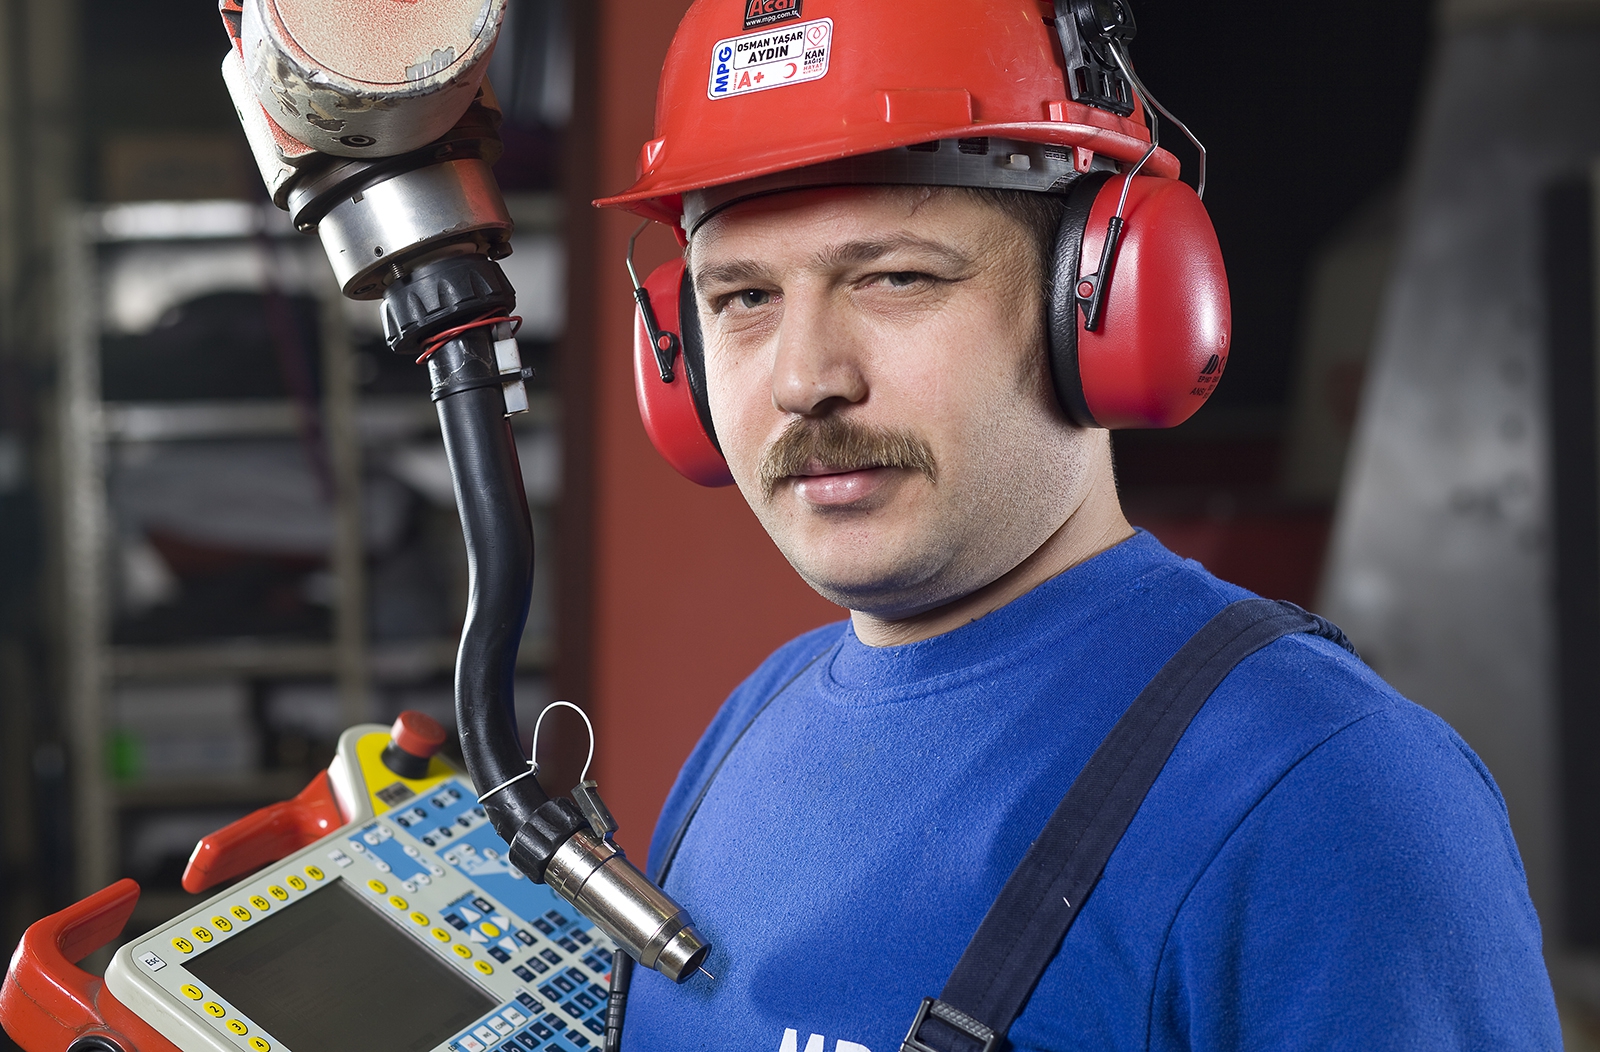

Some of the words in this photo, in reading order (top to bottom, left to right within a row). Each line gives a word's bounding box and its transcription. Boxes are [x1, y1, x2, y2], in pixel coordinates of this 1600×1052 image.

[745, 10, 798, 26] www.mpg.com.tr
[737, 38, 770, 52] OSMAN
[772, 31, 803, 45] YAŞAR
[748, 45, 789, 63] AYDIN
[804, 48, 825, 60] KAN
[715, 46, 732, 92] MPG
[737, 71, 764, 89] A+
[290, 878, 302, 888] F7
[272, 888, 284, 898] F6
[253, 898, 266, 908] F5
[234, 908, 246, 919] F4
[215, 919, 228, 929] F3
[196, 929, 209, 940] F2
[177, 940, 190, 950] F1
[144, 956, 160, 967] Esc
